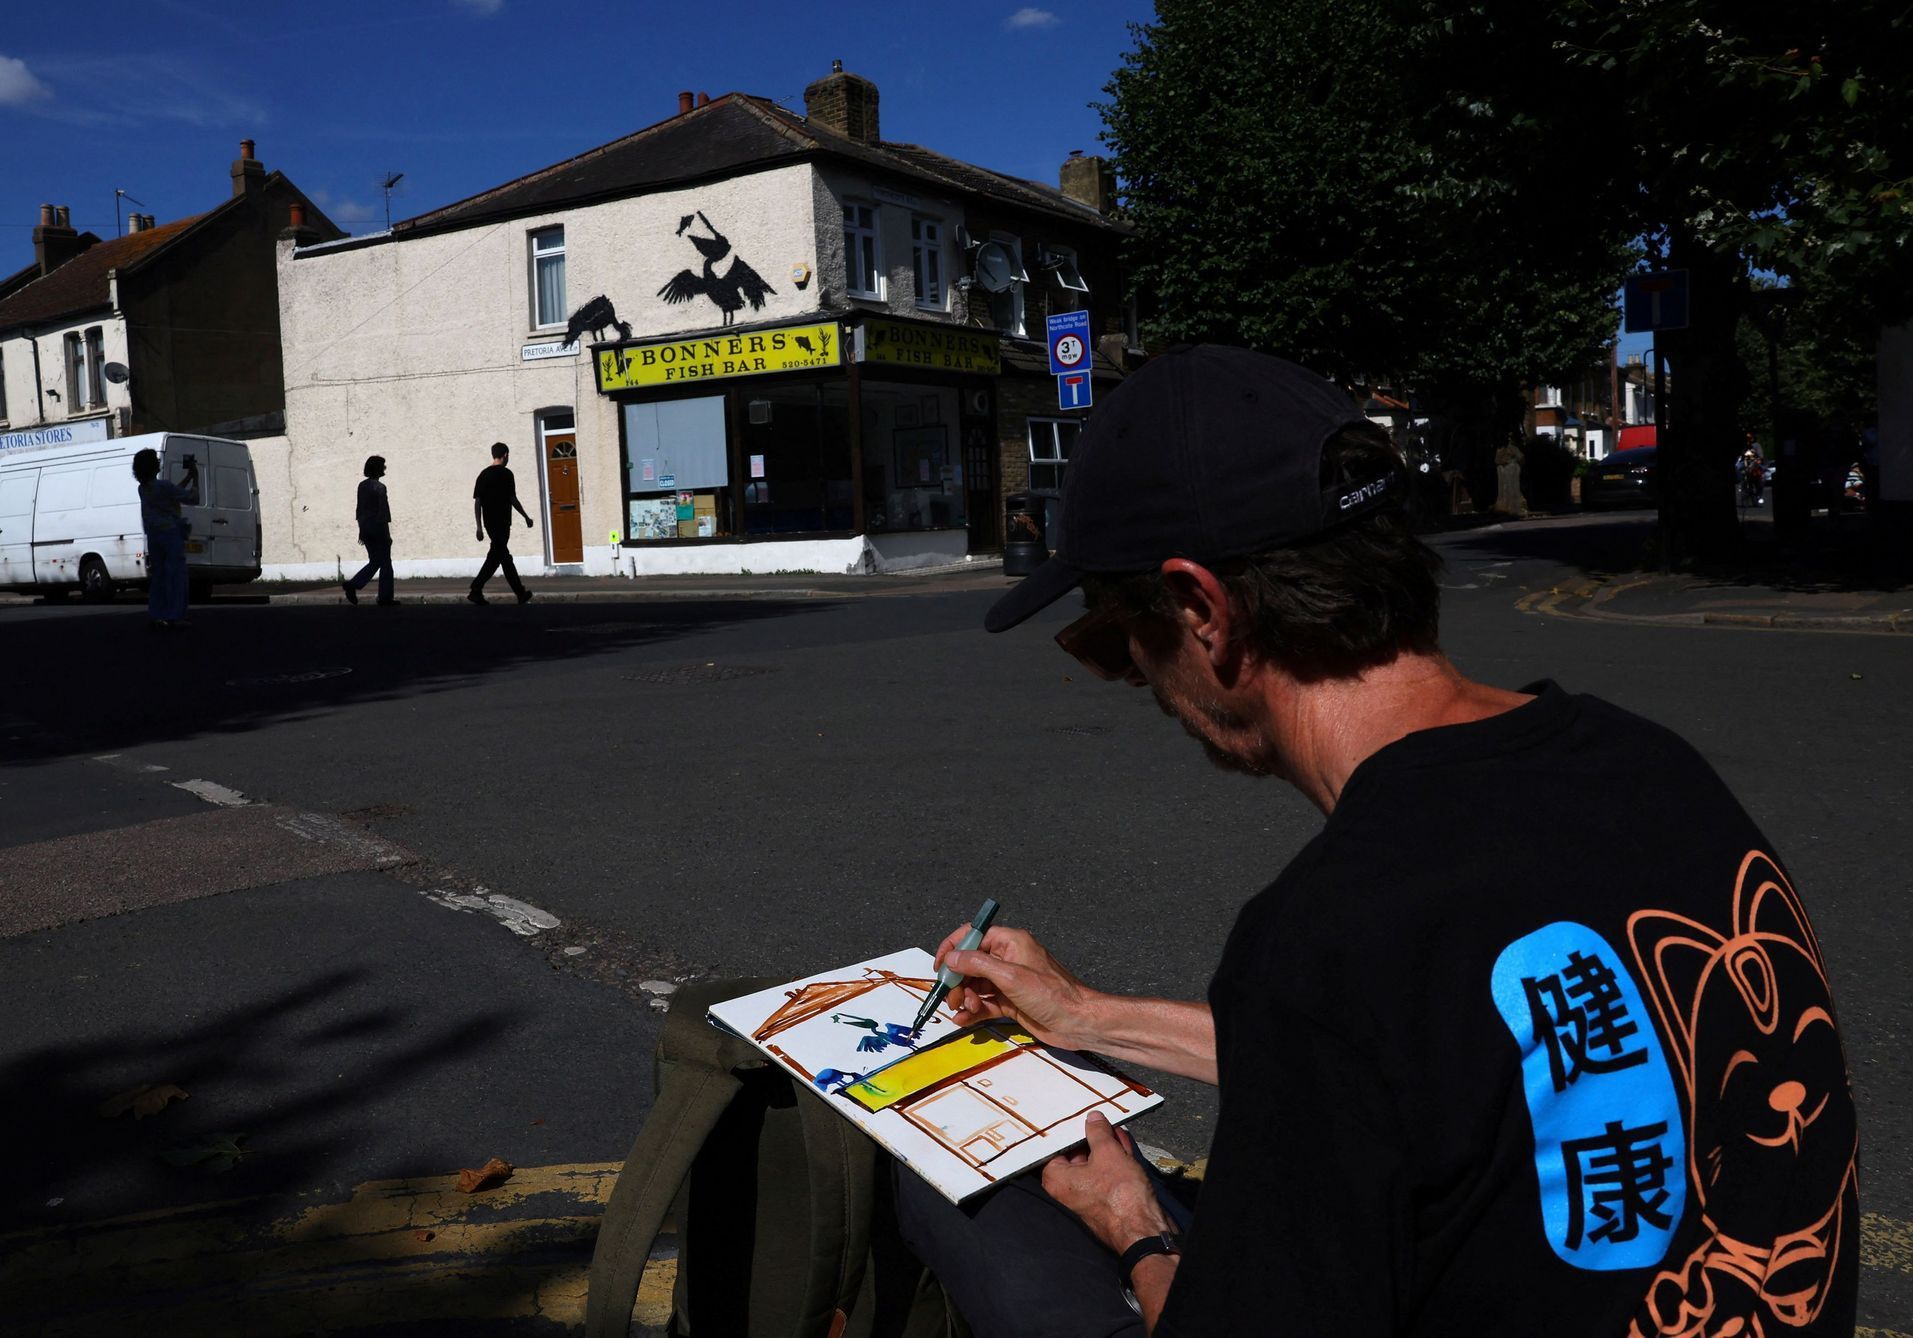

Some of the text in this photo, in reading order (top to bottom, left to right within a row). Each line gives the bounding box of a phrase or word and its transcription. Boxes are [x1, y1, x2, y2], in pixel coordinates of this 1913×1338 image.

[641, 333, 787, 366] BONNERS
[889, 326, 979, 354] BONNERS
[524, 346, 555, 357] PRETORIA
[896, 348, 932, 364] FISH
[943, 354, 973, 369] BAR
[664, 357, 767, 381] FISH BAR
[782, 357, 827, 370] 520-5471
[34, 427, 73, 445] STORES
[1521, 950, 1673, 1252] 健康
